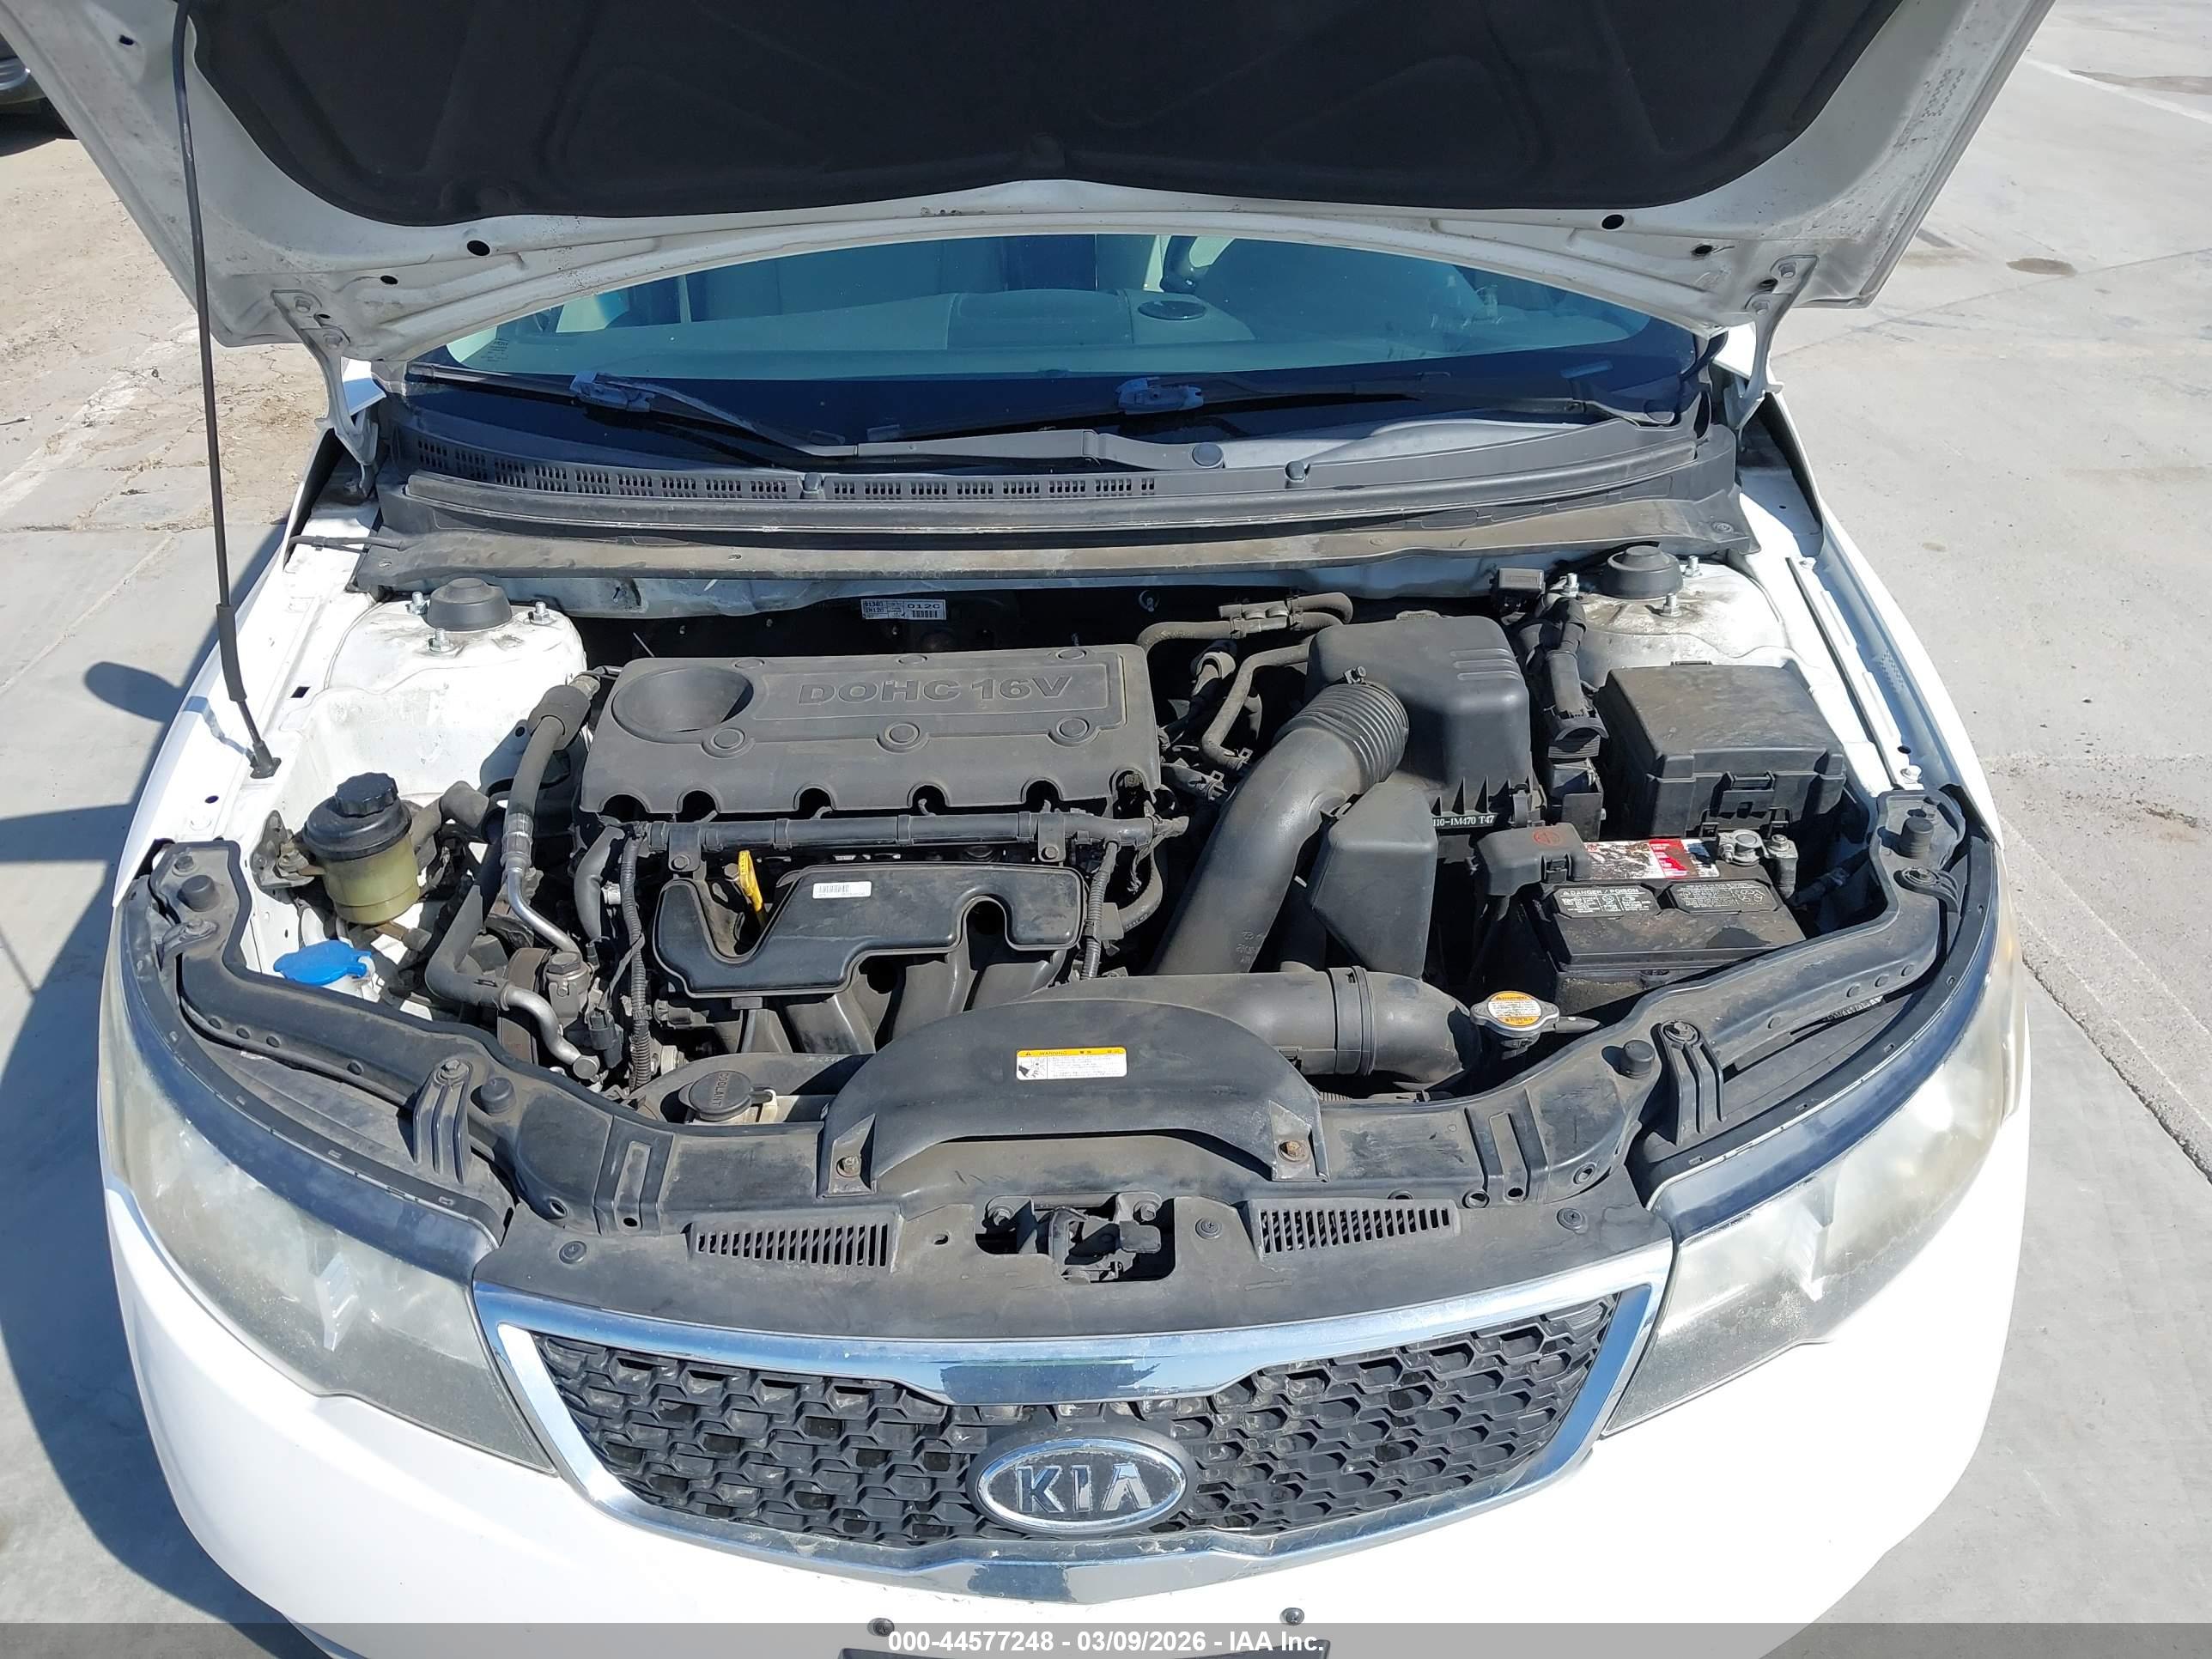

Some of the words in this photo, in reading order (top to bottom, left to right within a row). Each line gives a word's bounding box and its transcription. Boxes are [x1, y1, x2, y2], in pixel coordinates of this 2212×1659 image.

[798, 679, 962, 706] DOHC
[971, 676, 1073, 700] 16V
[1478, 815, 1495, 824] T47
[712, 1073, 728, 1107] COOLANT
[1015, 1462, 1153, 1513] KIA
